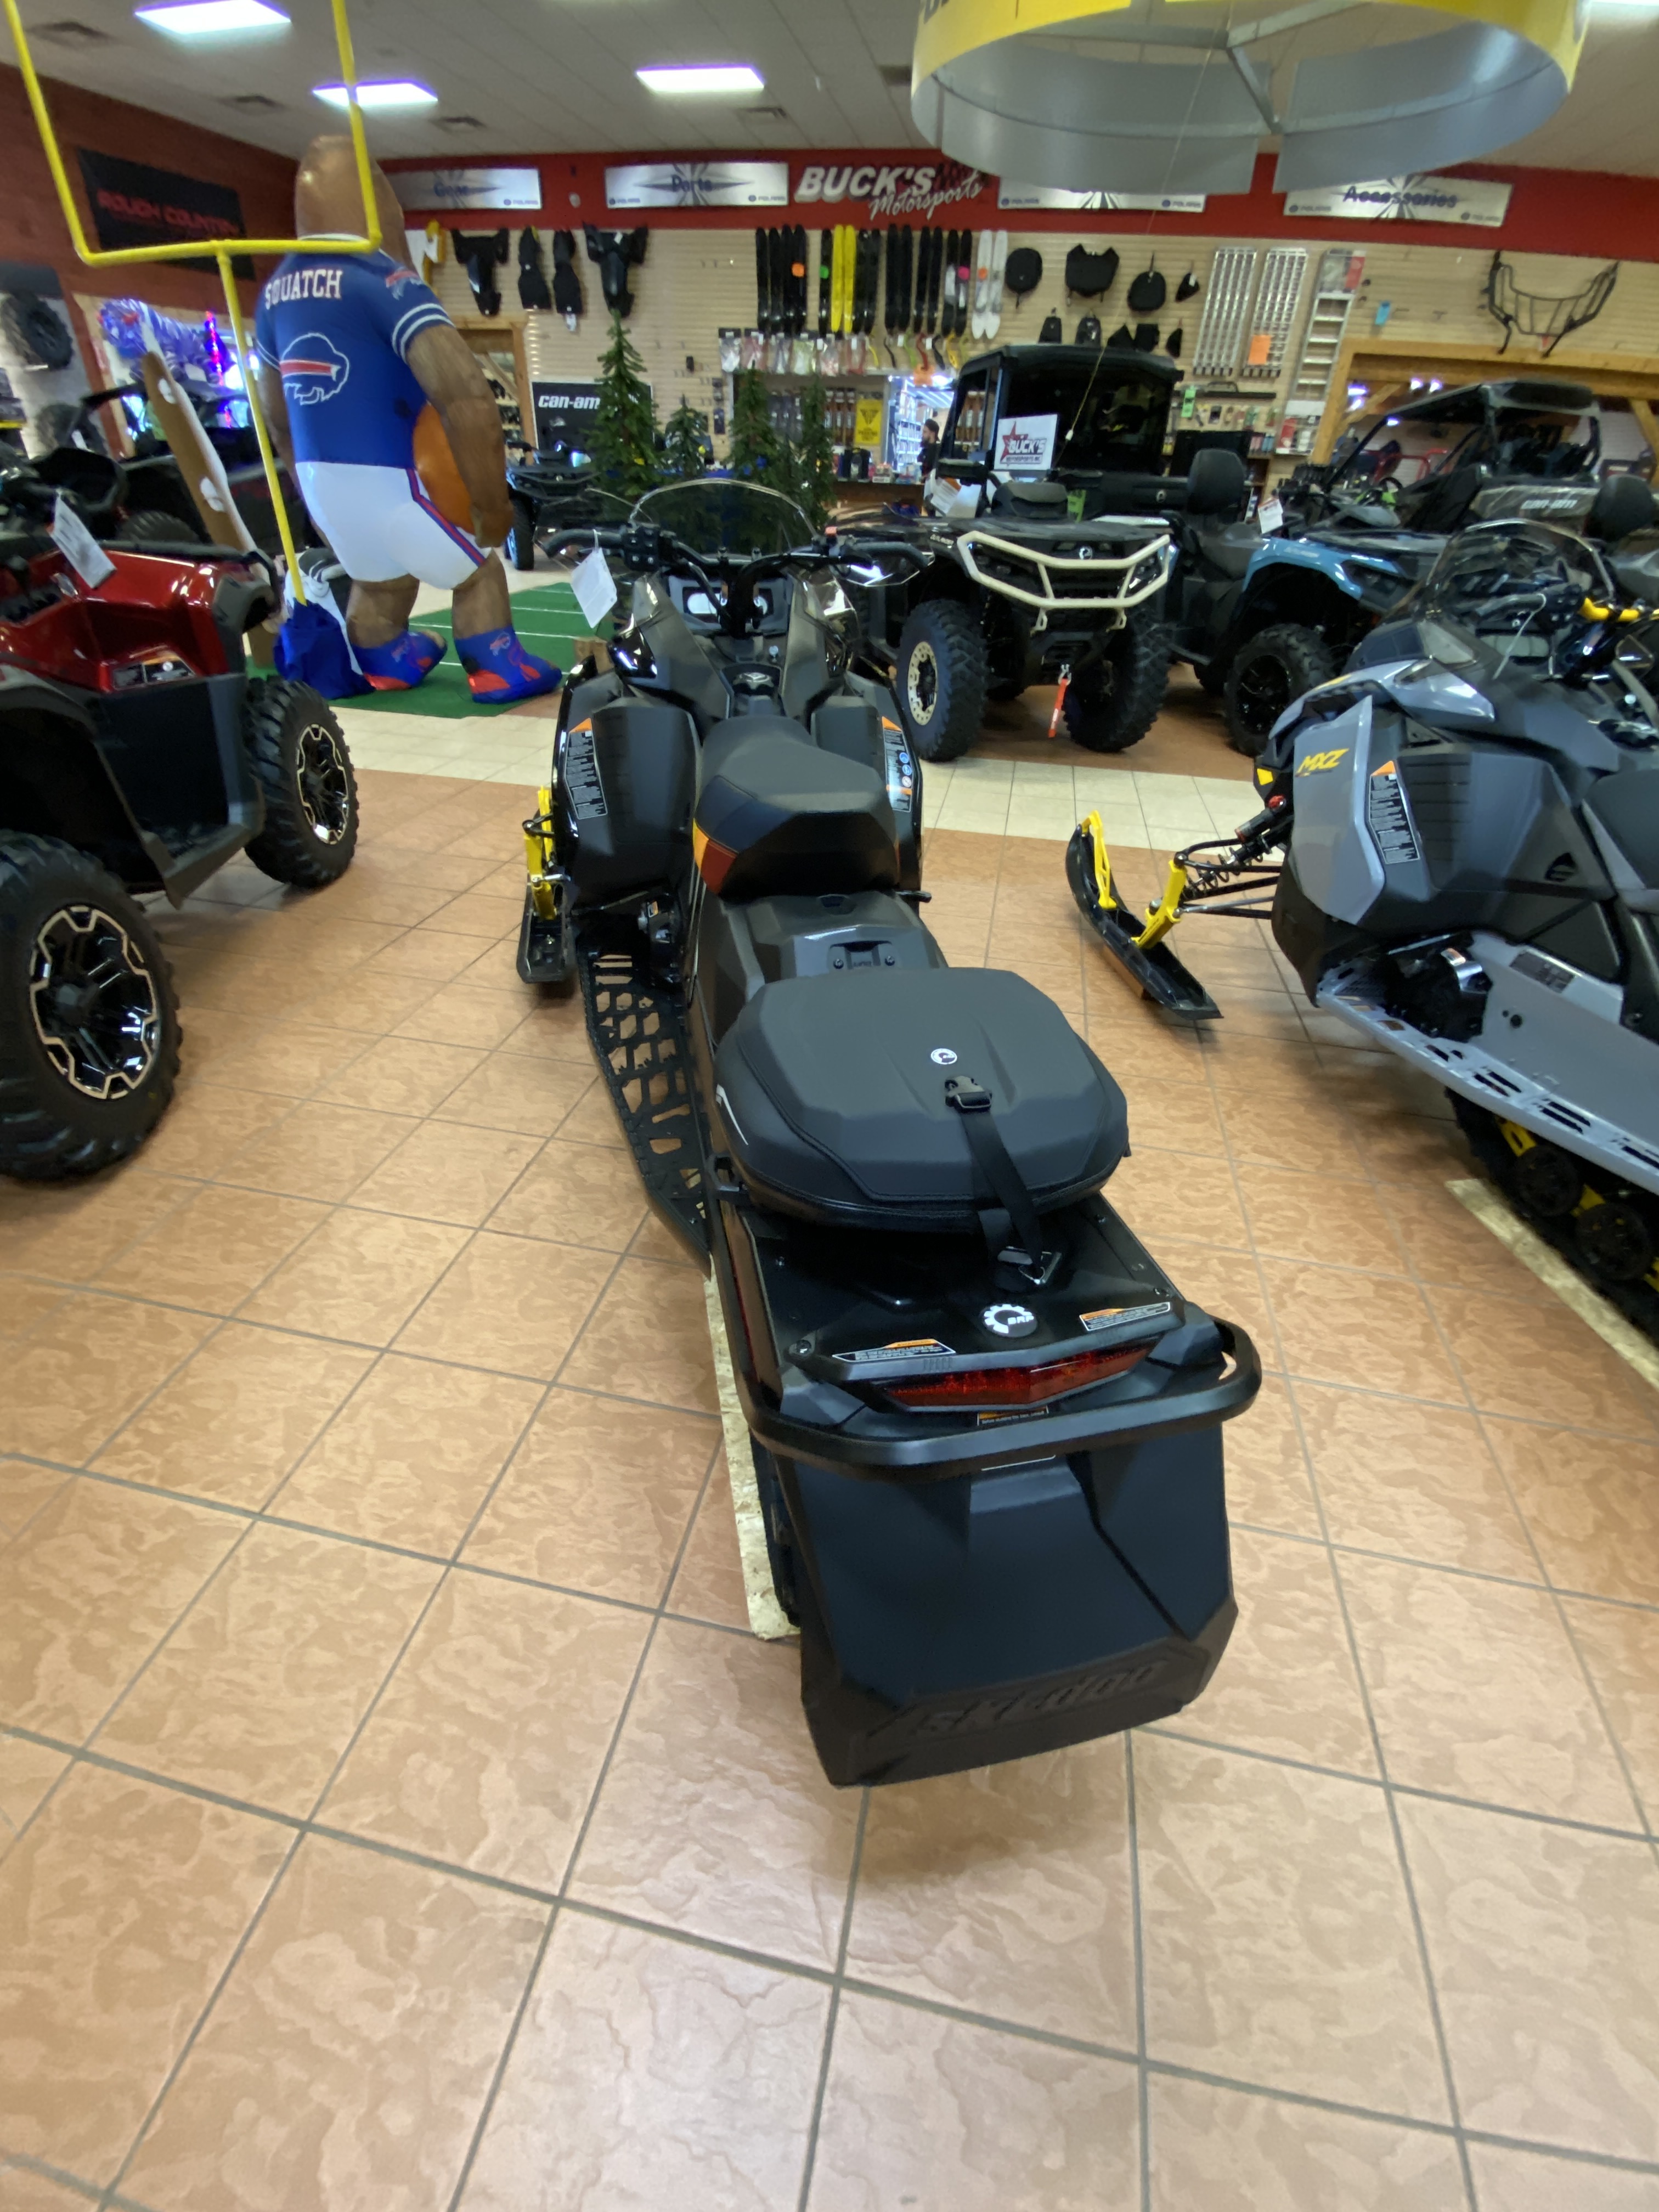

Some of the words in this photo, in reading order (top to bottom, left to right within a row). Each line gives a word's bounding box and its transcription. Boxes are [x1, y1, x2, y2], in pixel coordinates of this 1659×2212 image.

[795, 166, 936, 202] BUCK'S
[868, 169, 984, 222] Motorsports
[264, 268, 343, 311] SQUATCH
